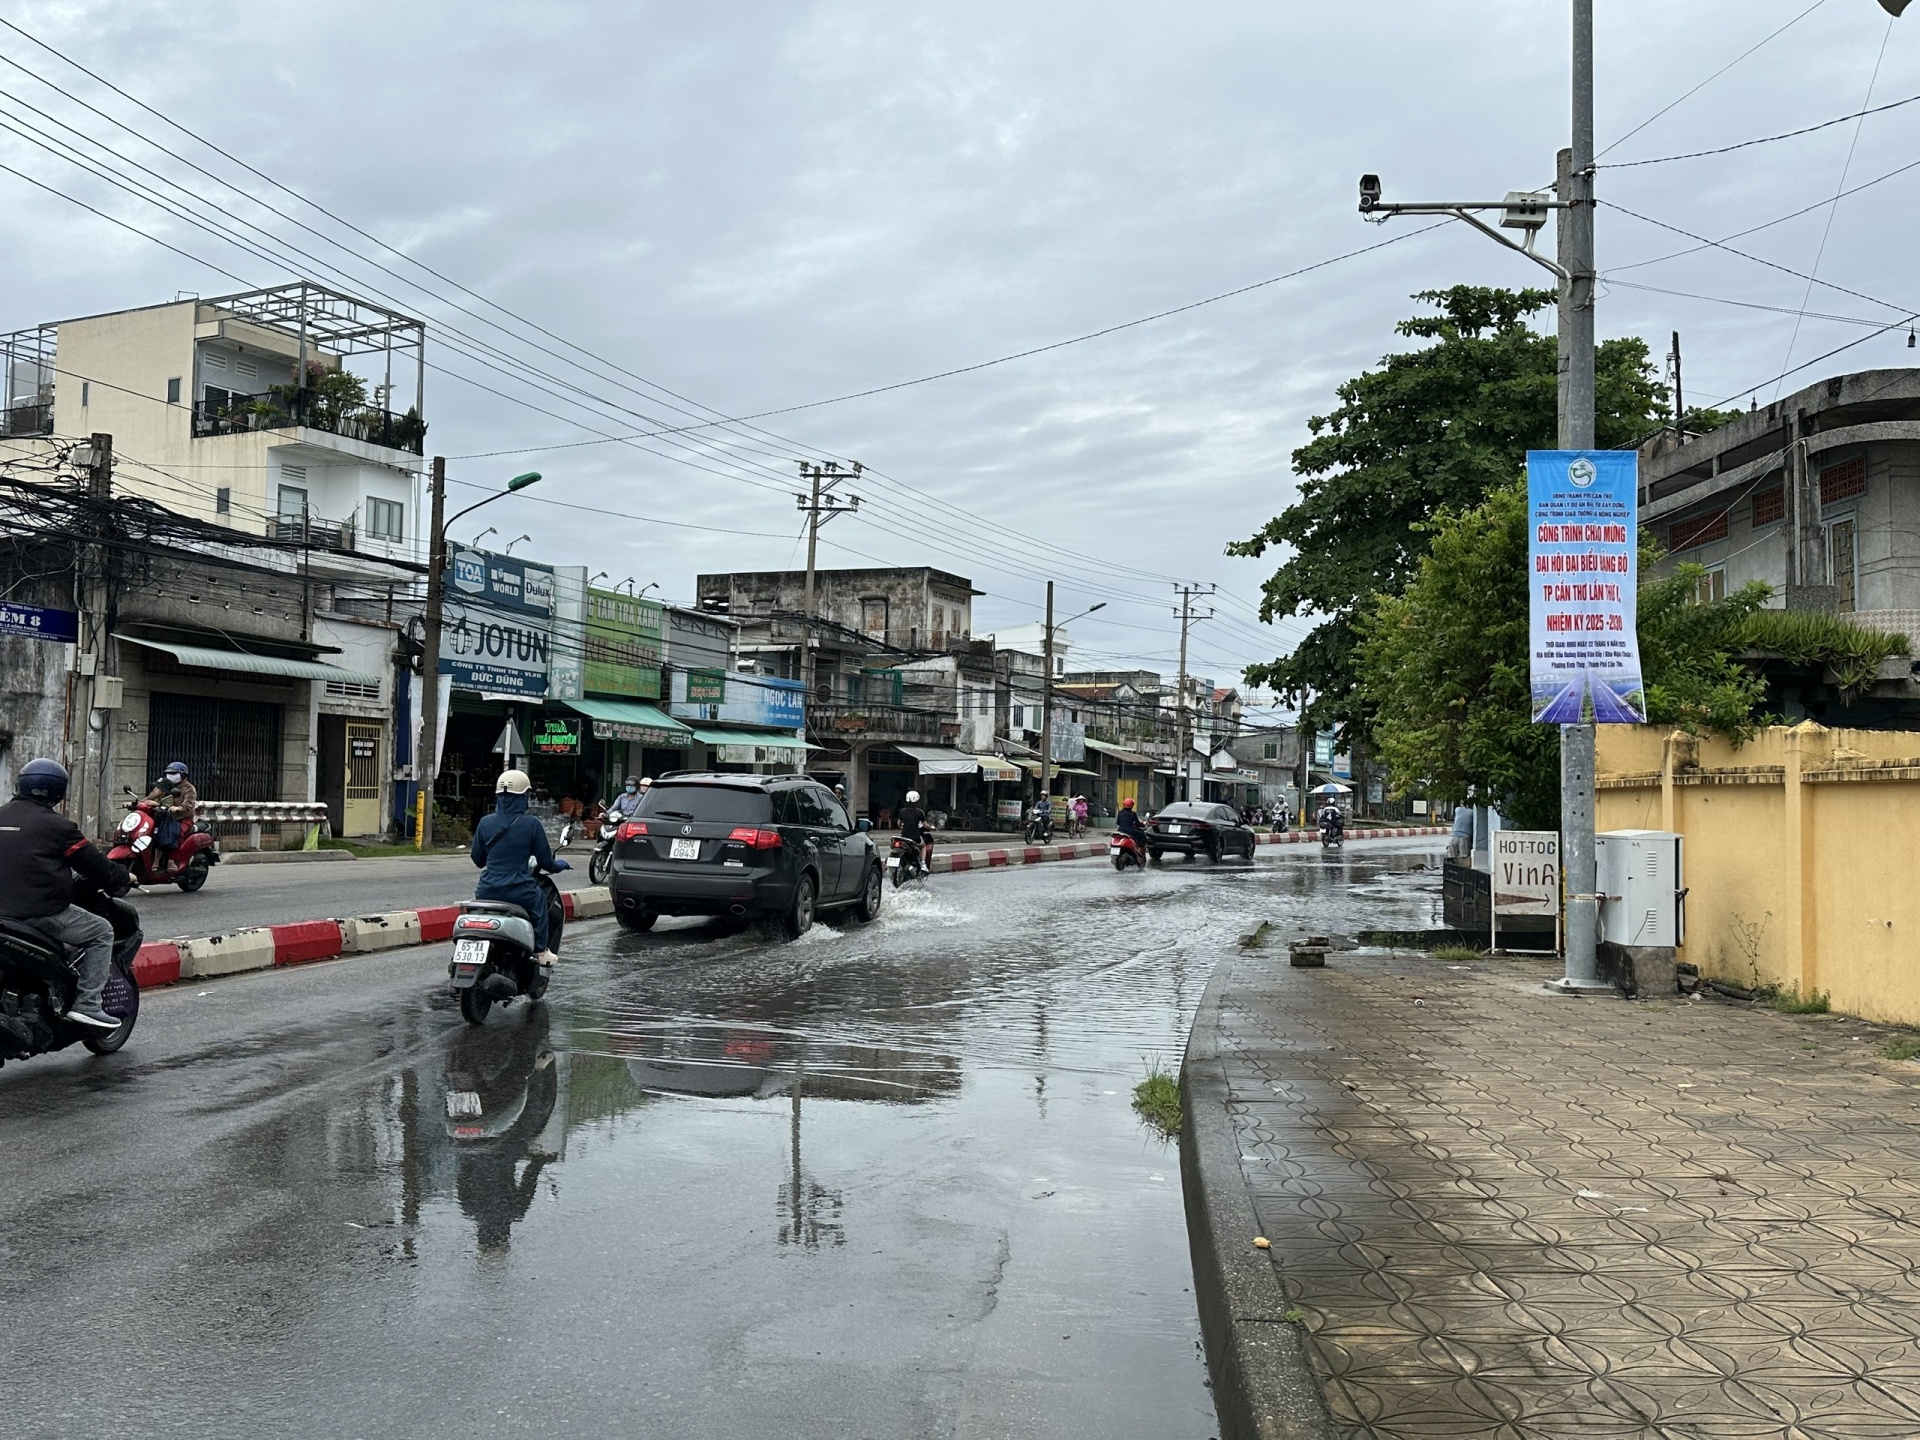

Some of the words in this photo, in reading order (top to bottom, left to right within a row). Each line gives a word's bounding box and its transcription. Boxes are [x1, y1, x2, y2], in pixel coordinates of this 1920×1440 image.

[1538, 522, 1559, 542] CÔNG
[1561, 522, 1582, 542] TRÌNH
[1604, 522, 1626, 542] MỪNG
[1536, 555, 1549, 576] ĐẠI
[1551, 552, 1564, 576] HỘI
[1566, 555, 1579, 575] ĐẠI
[1581, 548, 1598, 572] BIỂU
[1618, 552, 1628, 576] BỘ
[458, 561, 482, 583] TOA
[493, 582, 519, 596] WORLD
[526, 582, 550, 598] Dulux
[1543, 585, 1552, 601] TP
[1573, 583, 1588, 601] THƠ
[597, 594, 615, 621] TÂM
[617, 600, 634, 625] TRÀ
[636, 606, 659, 630] XANH
[30, 616, 41, 626] 8
[1546, 611, 1572, 635] NHIỆM
[1574, 610, 1584, 631] KỲ
[1586, 614, 1604, 631] 2025
[474, 622, 547, 663] JOTUN
[471, 672, 493, 682] ĐỨC
[764, 688, 786, 710] NGỌC
[788, 691, 803, 708] LAN
[545, 720, 567, 732] TRÀ
[674, 849, 695, 858] 0943
[462, 942, 484, 951] 65-AA
[456, 952, 485, 962] 530.13
